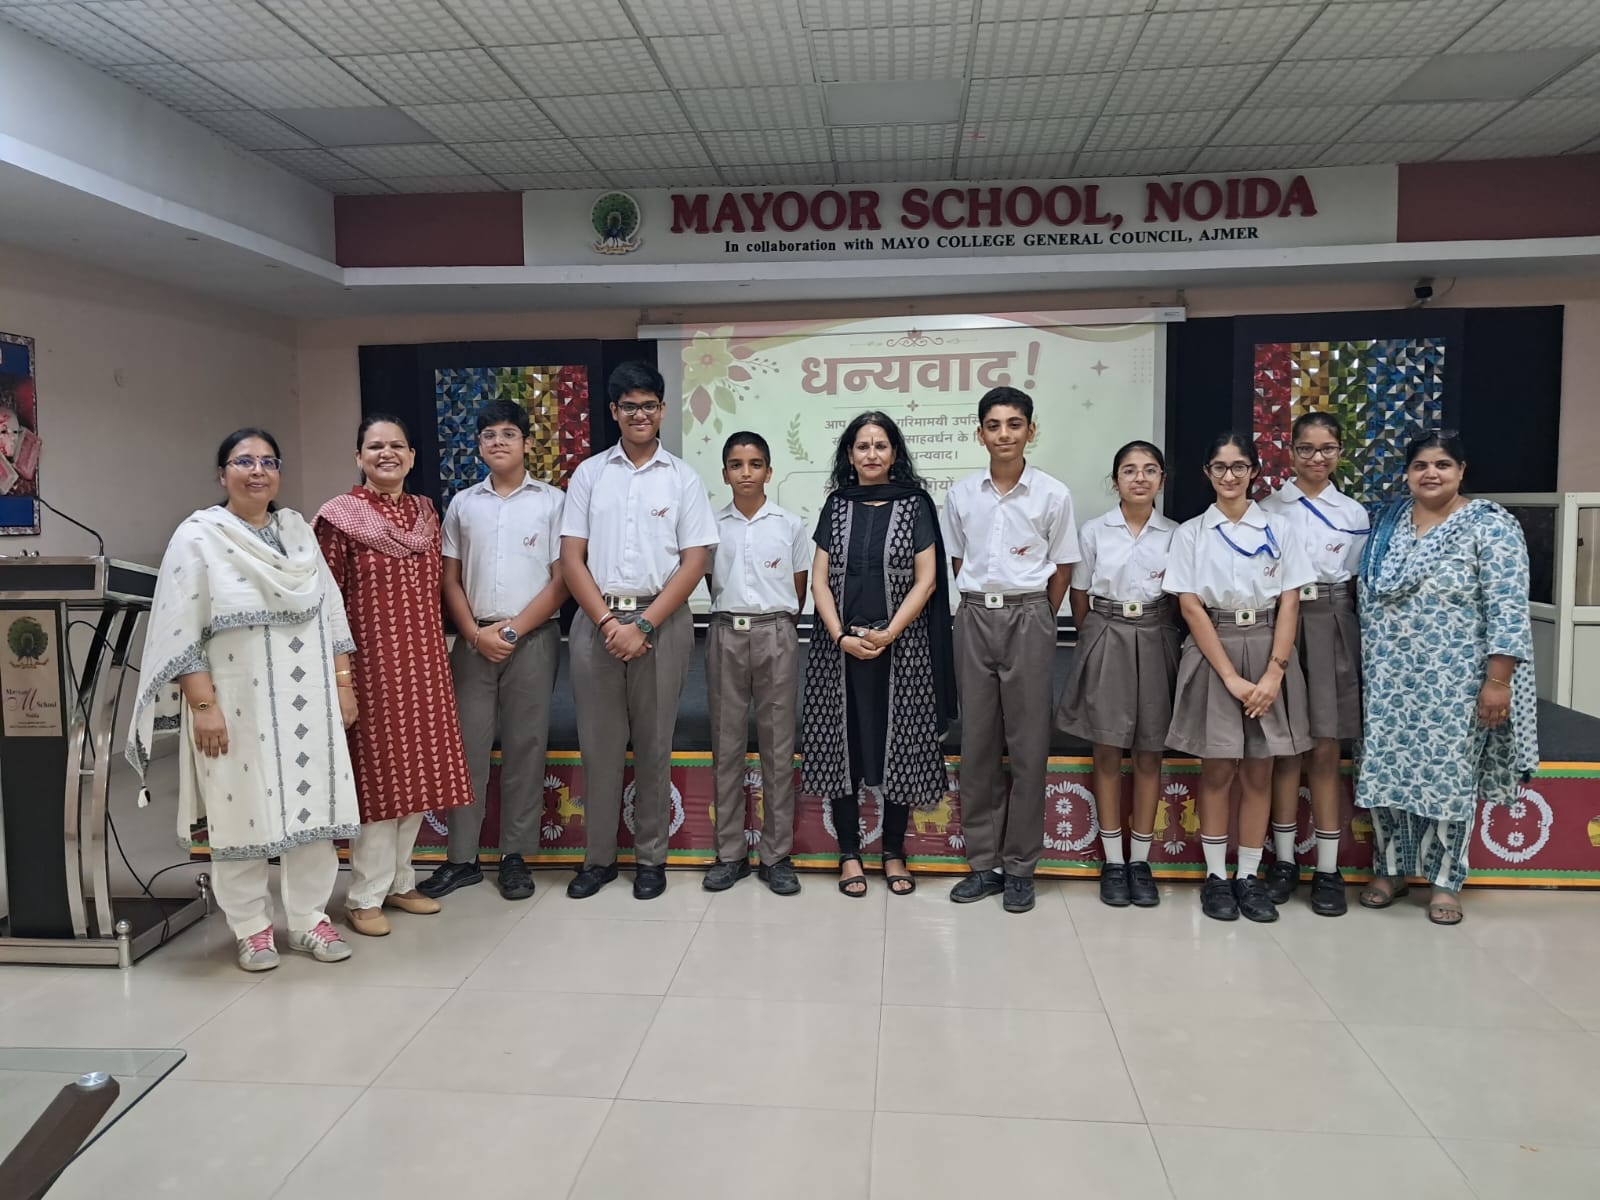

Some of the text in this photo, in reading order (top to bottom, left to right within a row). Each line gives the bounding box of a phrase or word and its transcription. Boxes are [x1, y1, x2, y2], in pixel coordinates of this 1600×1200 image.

[670, 174, 1318, 234] MAYOOR SCHOOL, NOIDA
[724, 226, 1259, 252] In collaboration with MAYO COLLEGE GENERAL COUNCIL, AJMER
[824, 420, 847, 430] आप
